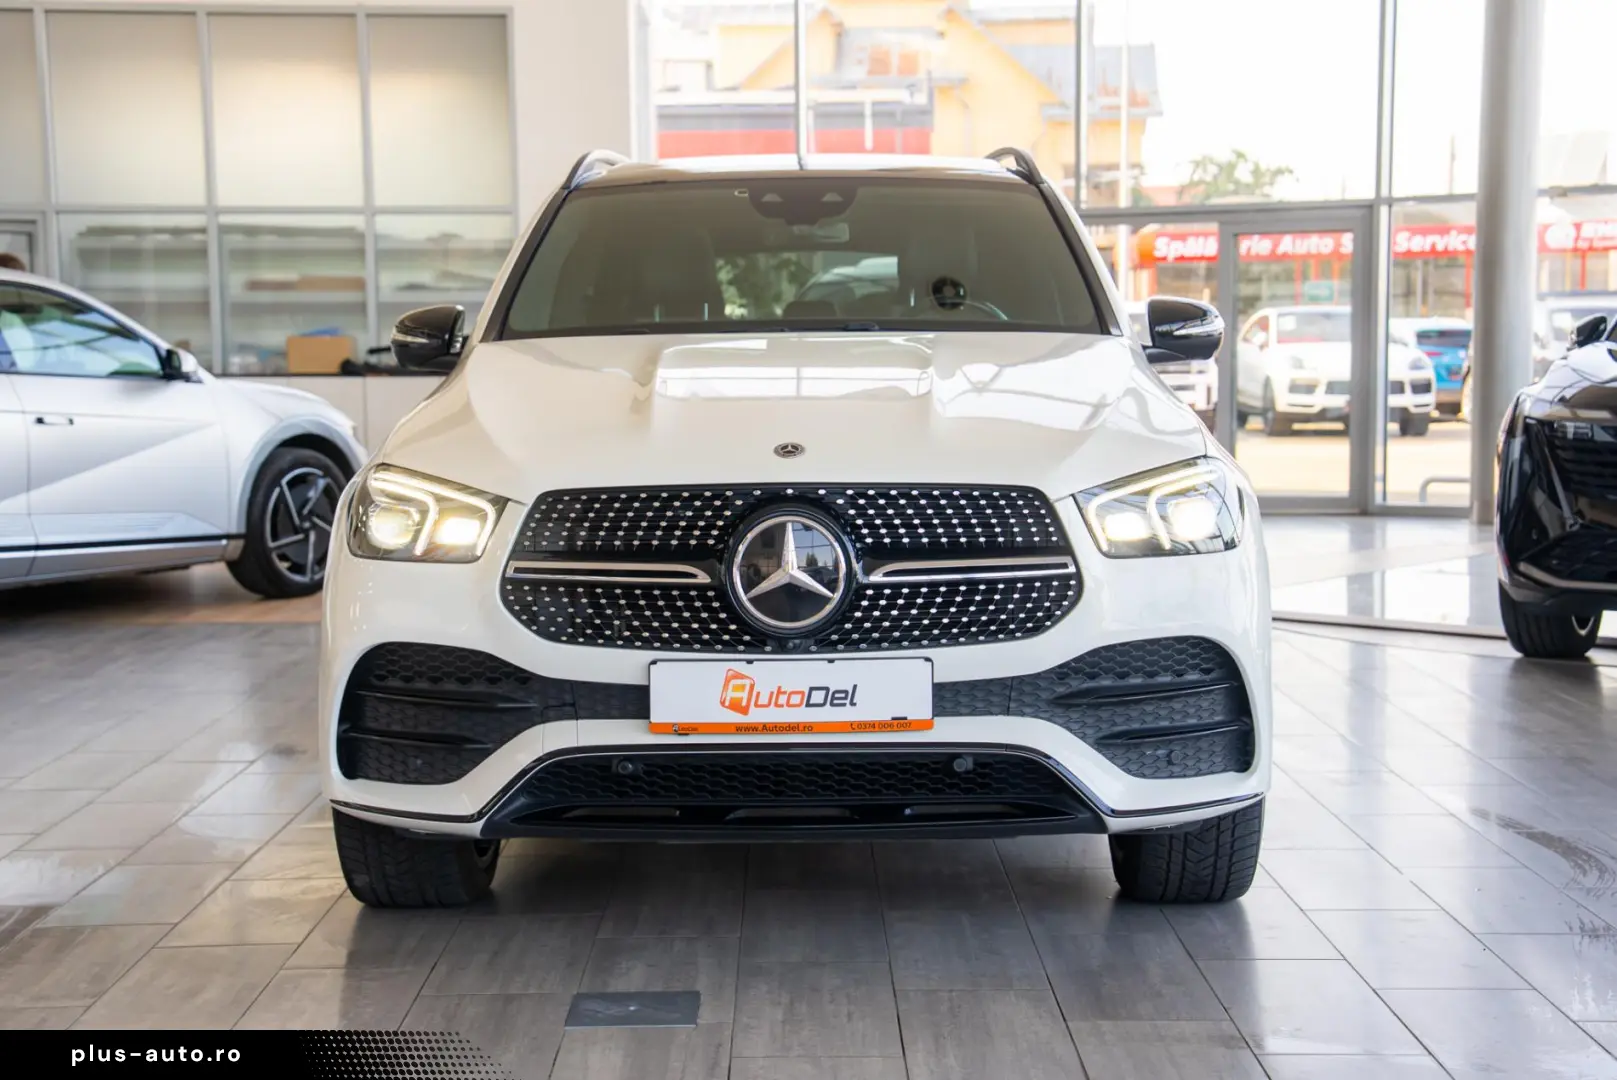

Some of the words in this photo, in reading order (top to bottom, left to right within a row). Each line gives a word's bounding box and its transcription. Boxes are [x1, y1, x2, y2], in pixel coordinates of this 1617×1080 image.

[1276, 234, 1334, 255] Auto
[724, 678, 858, 708] AutoDel
[735, 723, 813, 733] www.Autodel.ro
[896, 721, 912, 729] 007
